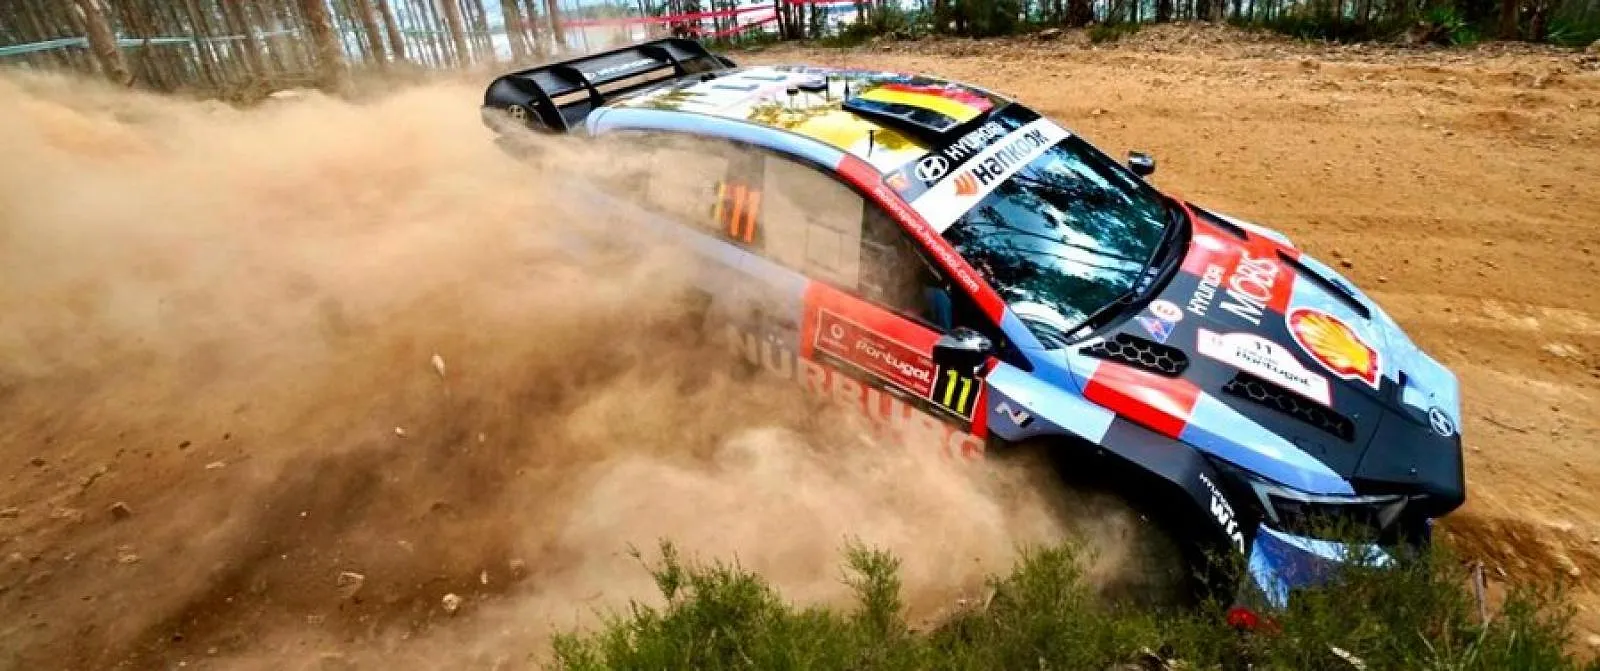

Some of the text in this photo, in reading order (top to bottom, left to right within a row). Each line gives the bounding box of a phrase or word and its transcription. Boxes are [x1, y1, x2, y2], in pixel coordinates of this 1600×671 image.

[943, 119, 1008, 161] HYUNDAI
[1186, 264, 1227, 317] HYUNDAI
[1219, 248, 1279, 327] MOBIS
[855, 340, 931, 384] Portugal
[945, 368, 973, 415] 11
